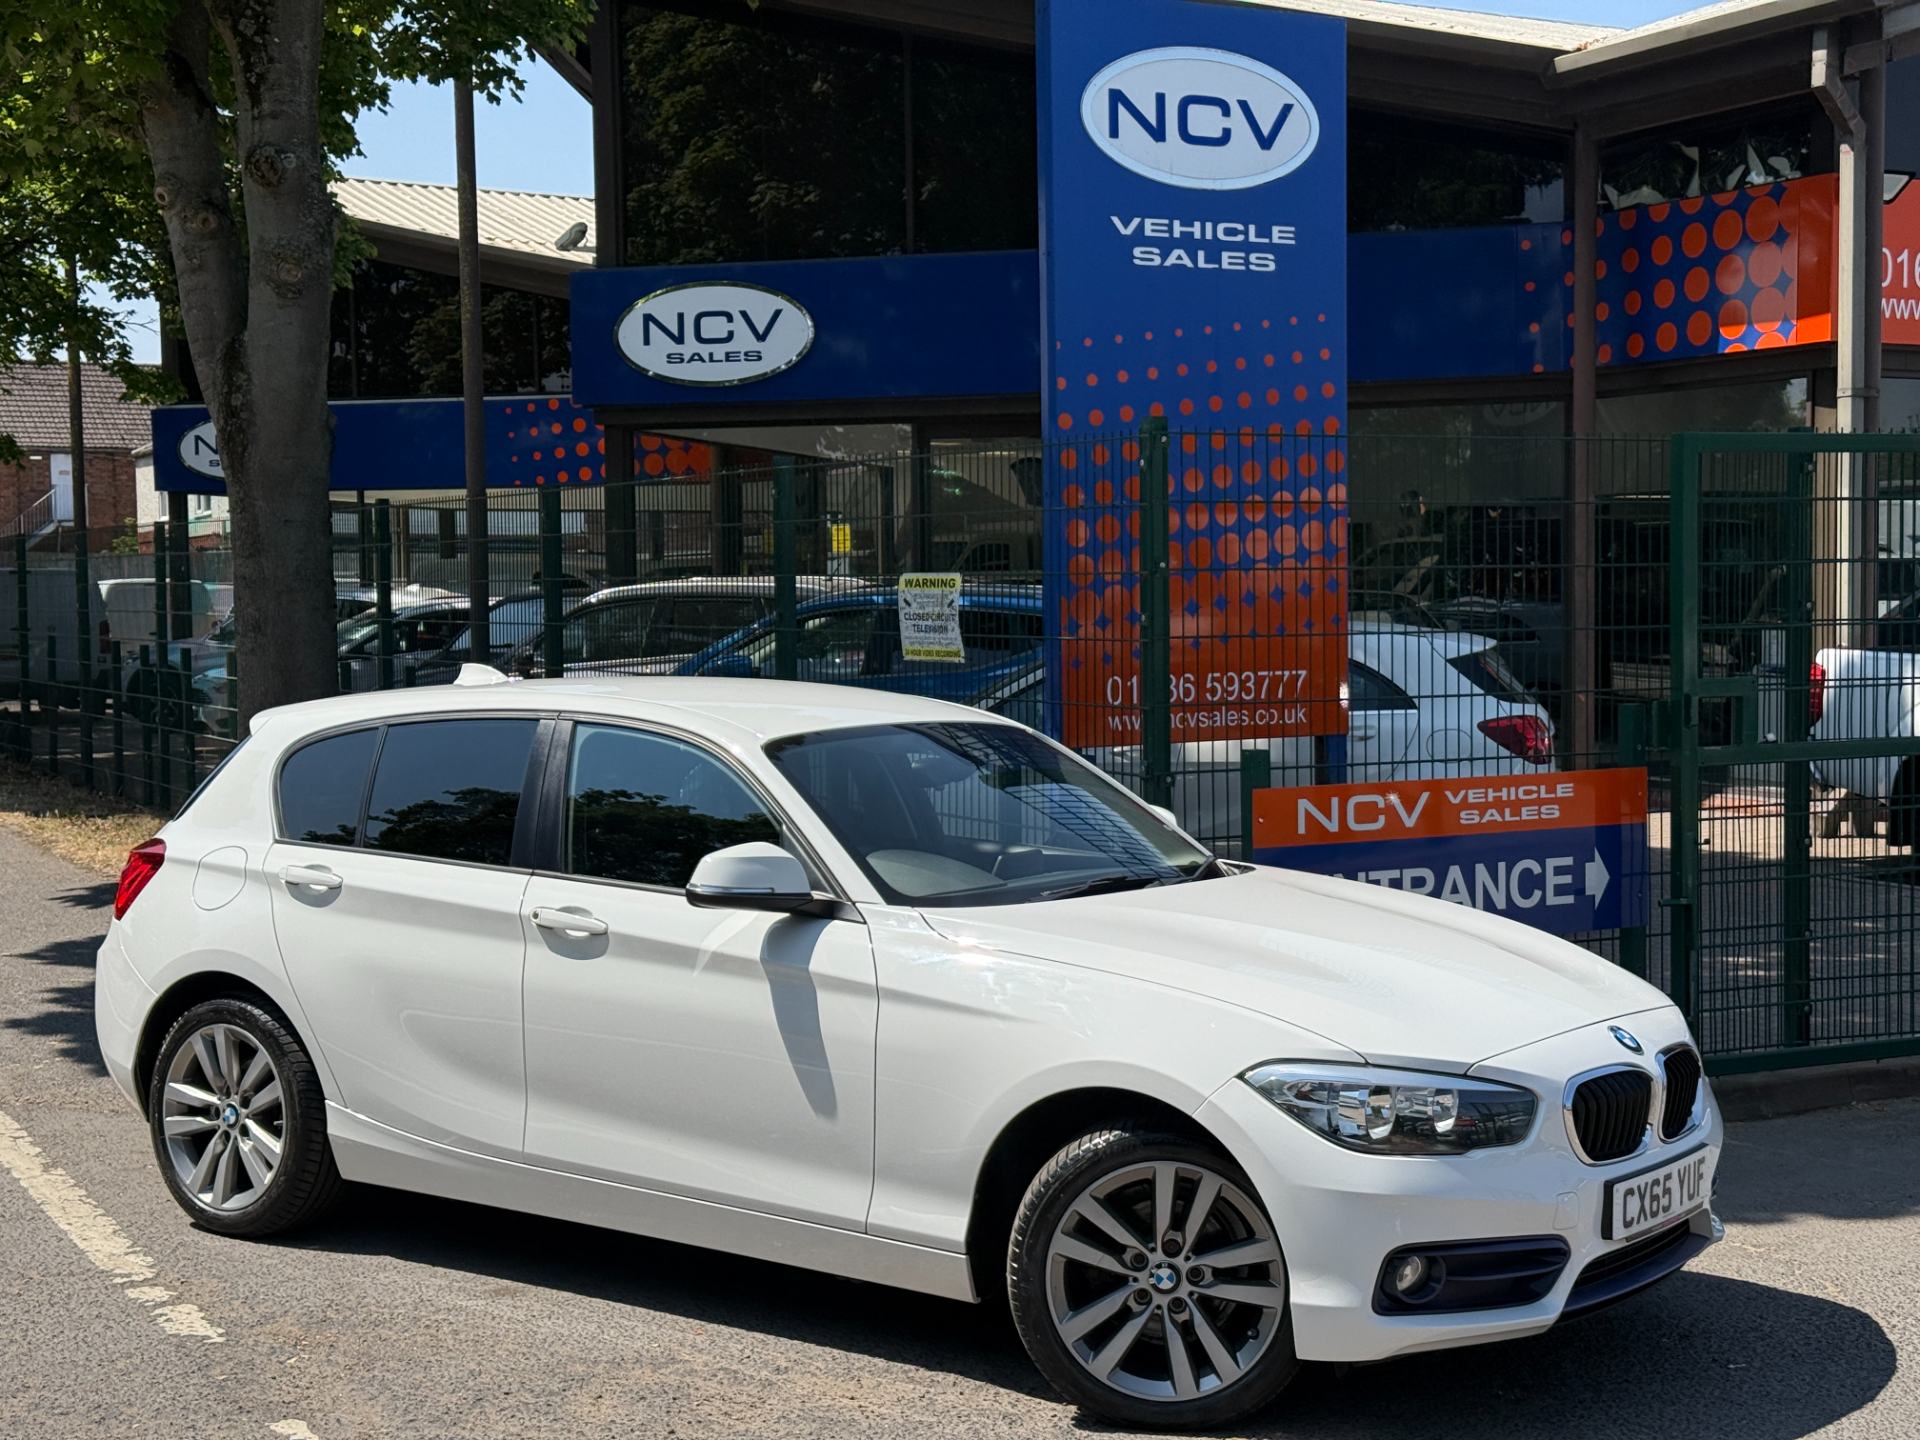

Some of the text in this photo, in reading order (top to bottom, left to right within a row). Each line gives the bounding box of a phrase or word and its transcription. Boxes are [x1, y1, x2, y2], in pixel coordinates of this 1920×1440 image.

[1108, 88, 1294, 150] NCV
[1110, 215, 1296, 245] VEHICLE
[1132, 247, 1276, 272] SALES
[642, 308, 783, 346] NCV
[666, 350, 762, 364] SALES
[904, 578, 956, 588] WARNING
[904, 612, 930, 621] CLOSED
[912, 624, 949, 634] TELEVISION
[1107, 670, 1307, 705] 0136 593777
[1108, 704, 1307, 731] wwcvsales.co.uk
[1297, 783, 1574, 834] NCV VEHICLE
[1459, 805, 1560, 825] SALES
[1622, 1156, 1706, 1229] CX65 YUF
